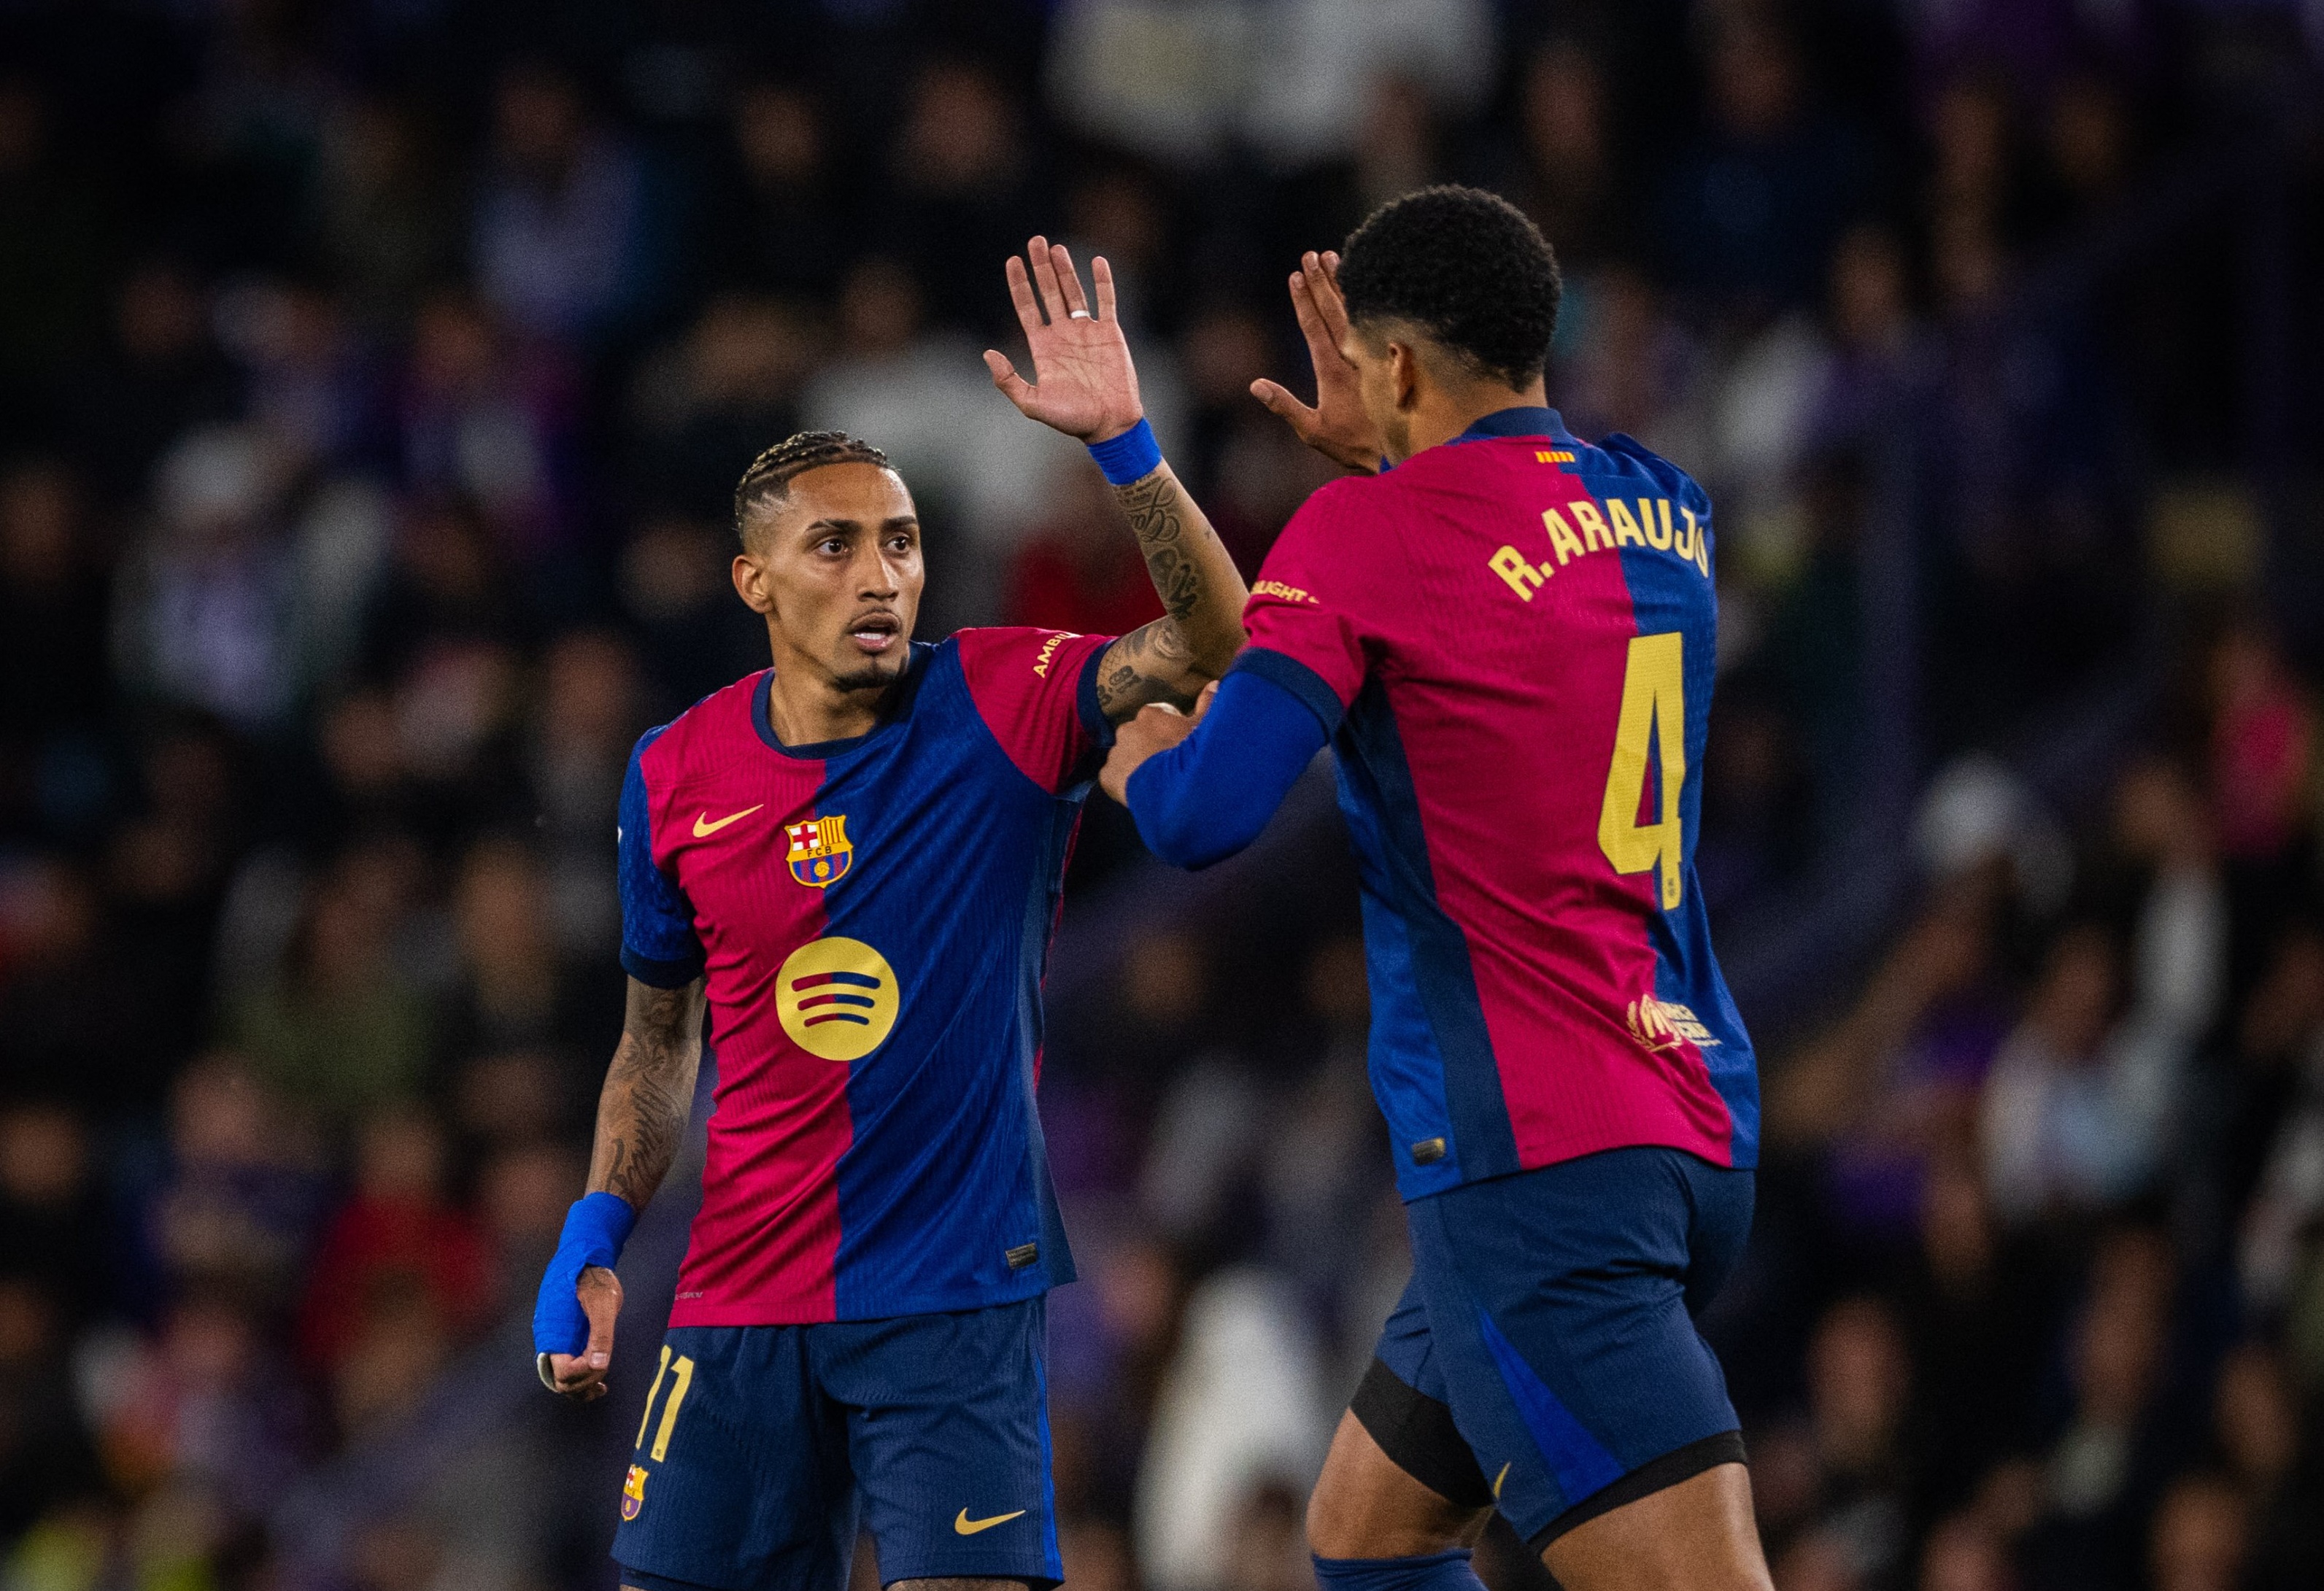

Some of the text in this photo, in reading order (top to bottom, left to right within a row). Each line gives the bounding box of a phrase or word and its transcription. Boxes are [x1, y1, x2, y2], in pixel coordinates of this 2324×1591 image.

[1541, 498, 1709, 578] ARAUJO
[1597, 631, 1686, 910] 4
[635, 1344, 695, 1463] 11
